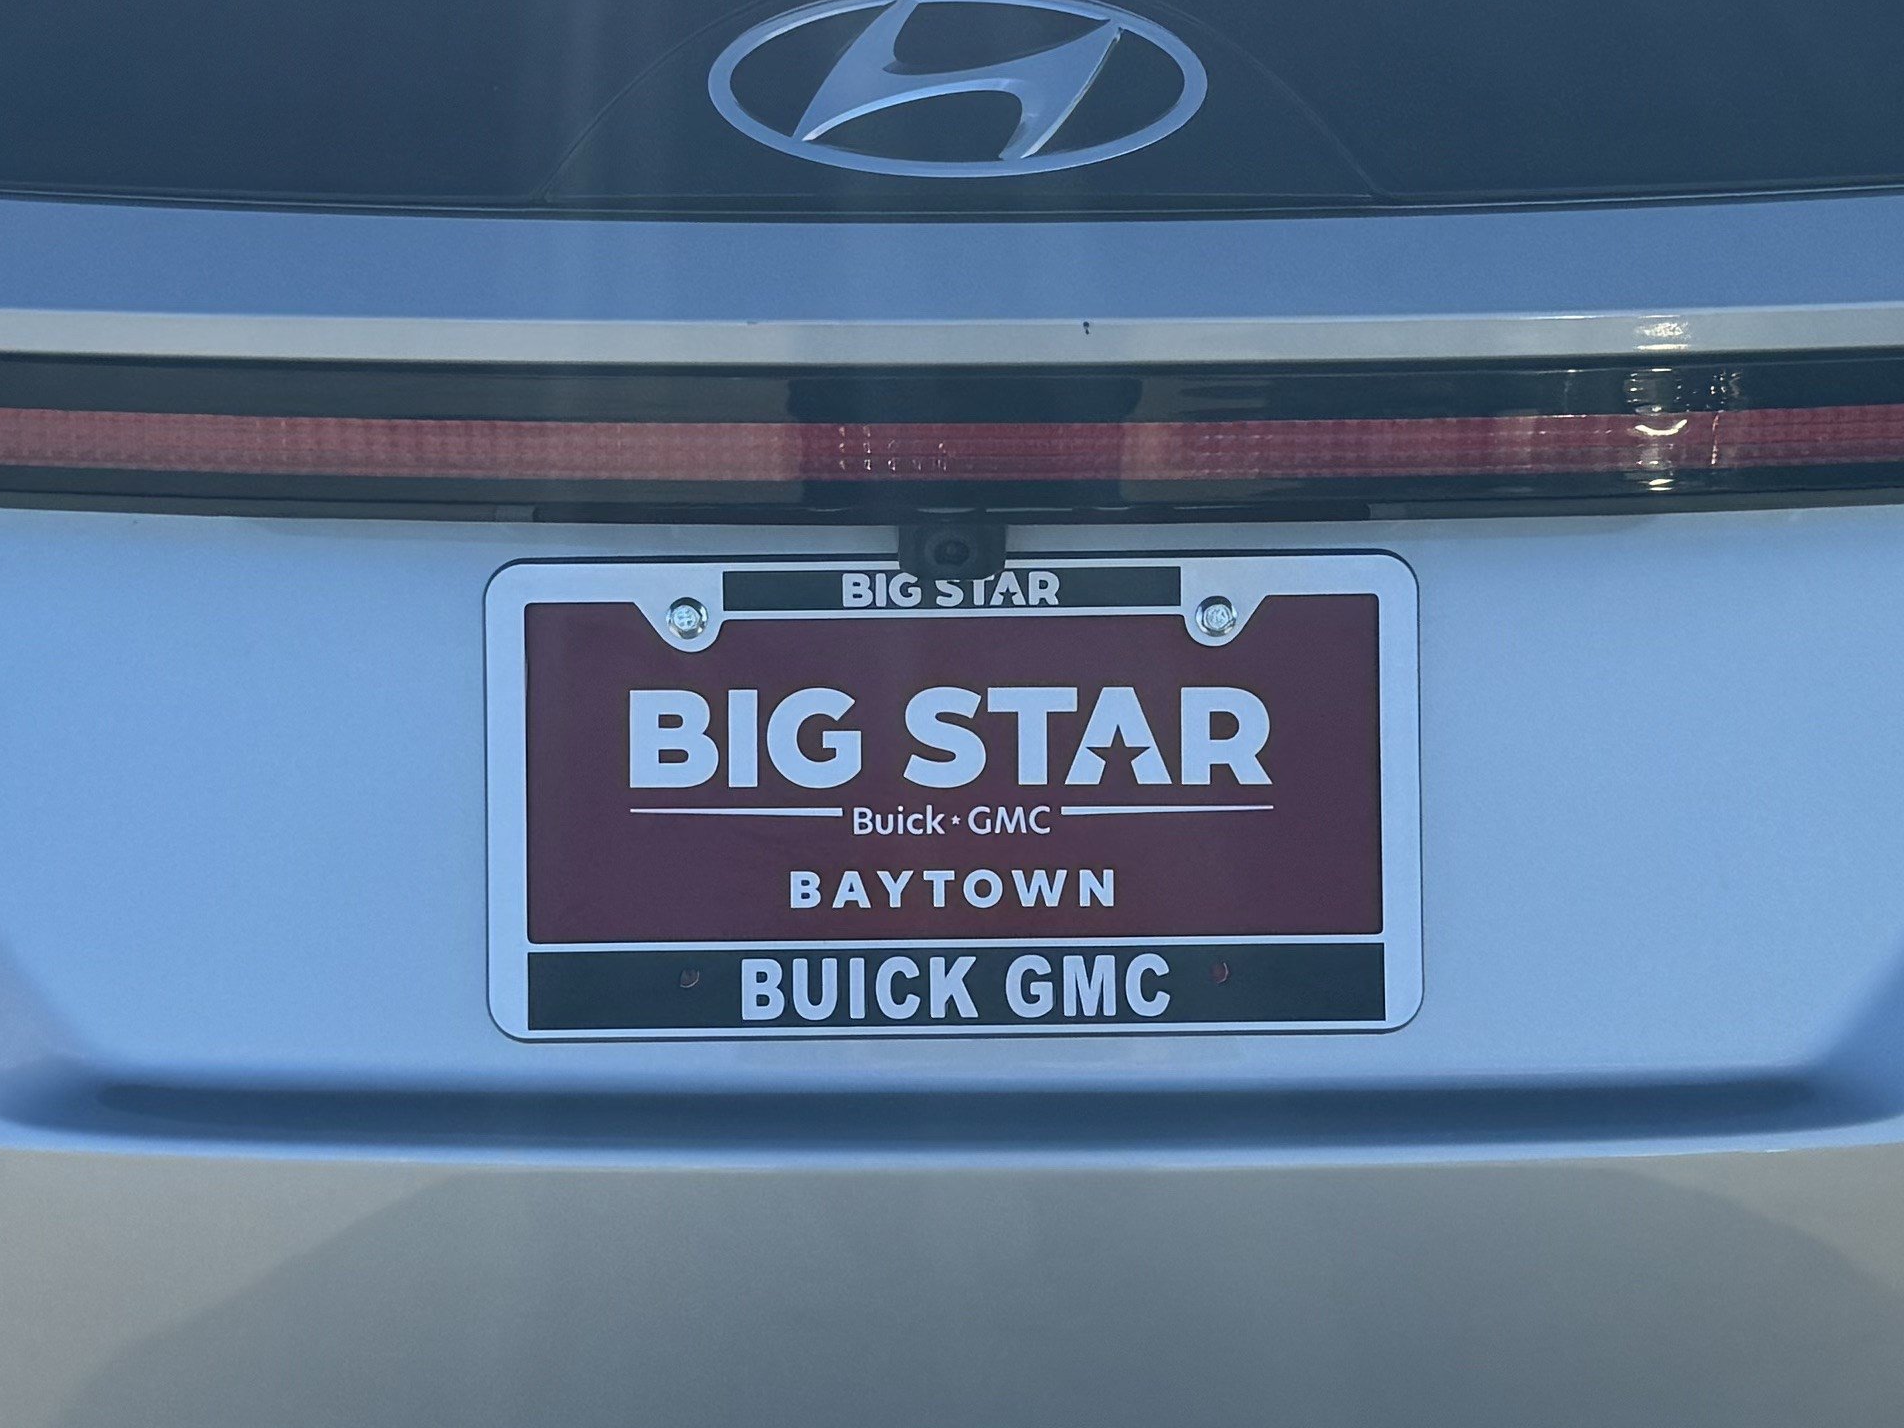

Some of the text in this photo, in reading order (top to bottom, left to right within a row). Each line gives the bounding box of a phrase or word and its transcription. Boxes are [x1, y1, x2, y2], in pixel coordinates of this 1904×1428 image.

[841, 571, 1060, 608] BIG STAR
[629, 684, 1273, 789] BIG STAR
[853, 804, 1051, 835] Buick GMC
[790, 868, 1115, 909] BAYTOWN
[741, 953, 1171, 1020] BUICK GMC
